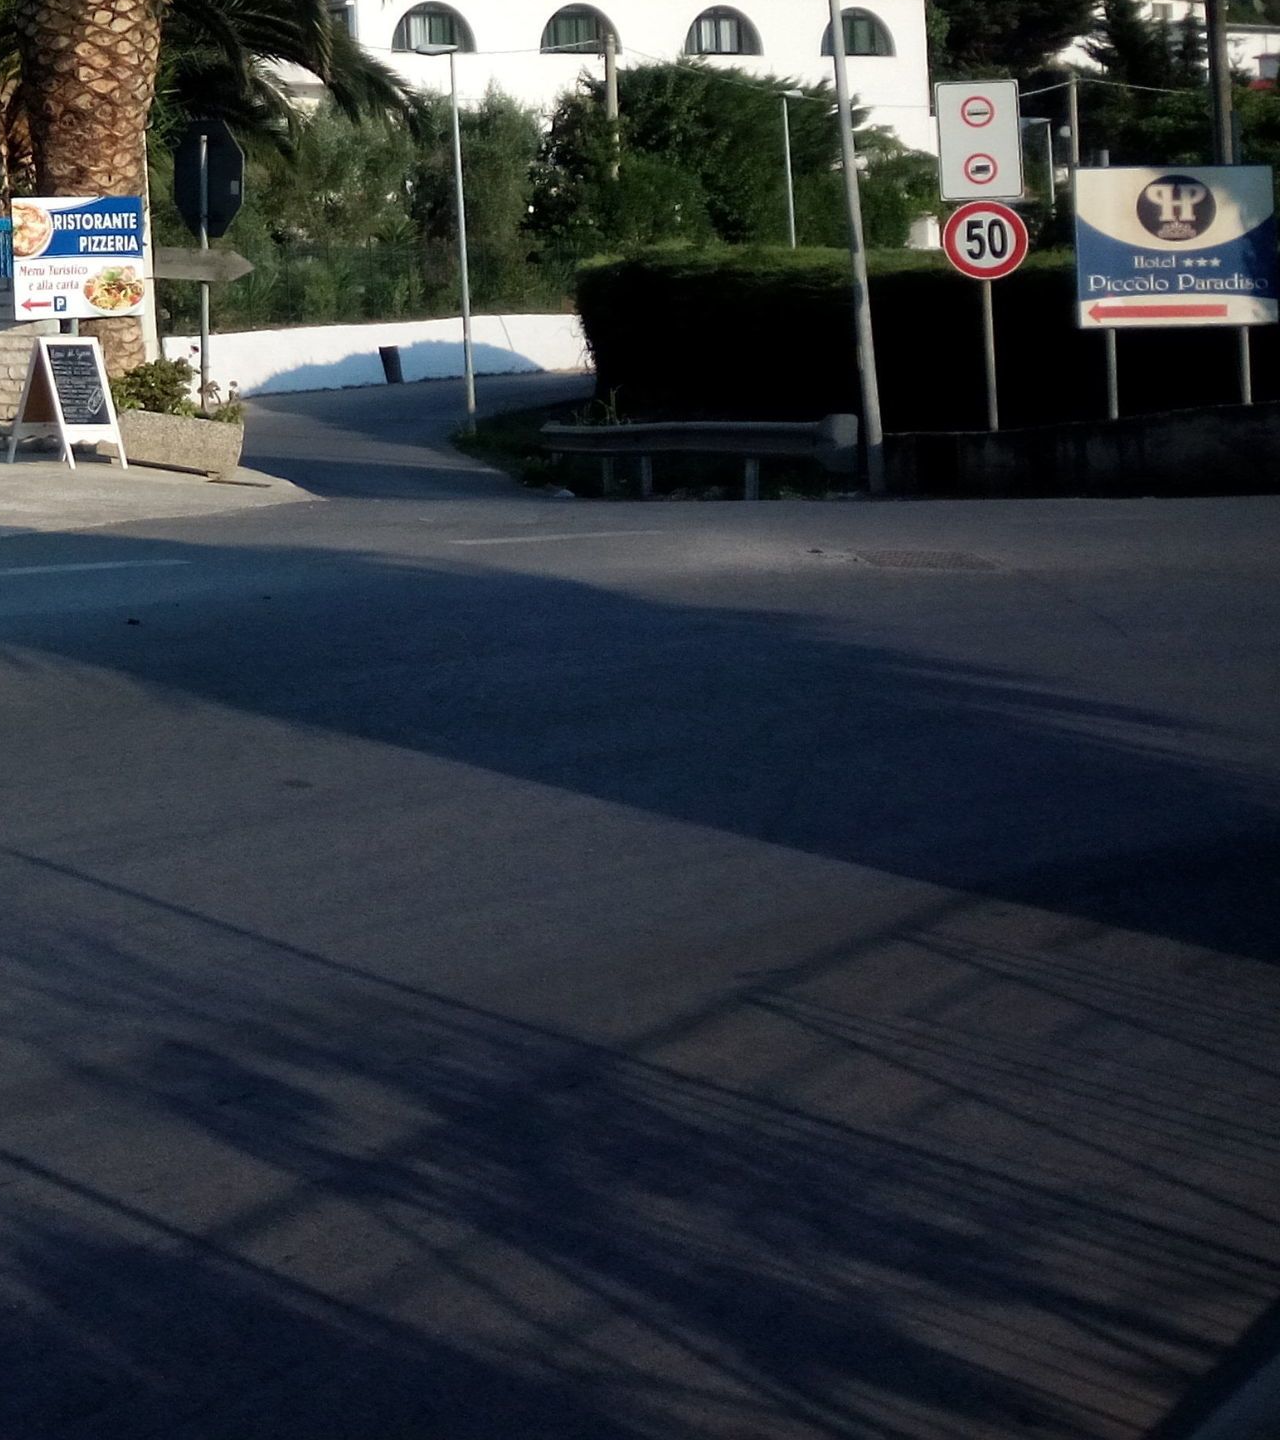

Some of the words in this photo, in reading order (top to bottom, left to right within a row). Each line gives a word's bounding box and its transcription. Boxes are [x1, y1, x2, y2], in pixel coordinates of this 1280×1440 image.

[53, 212, 137, 230] RISTORANTE
[79, 235, 138, 252] PIZZERIA
[965, 217, 1008, 260] 50
[49, 265, 88, 276] Turistico
[1133, 255, 1176, 269] Hotel
[36, 280, 53, 290] alla
[56, 280, 79, 290] carta
[1088, 274, 1169, 292] Piccolo
[1177, 272, 1268, 291] Paradiso
